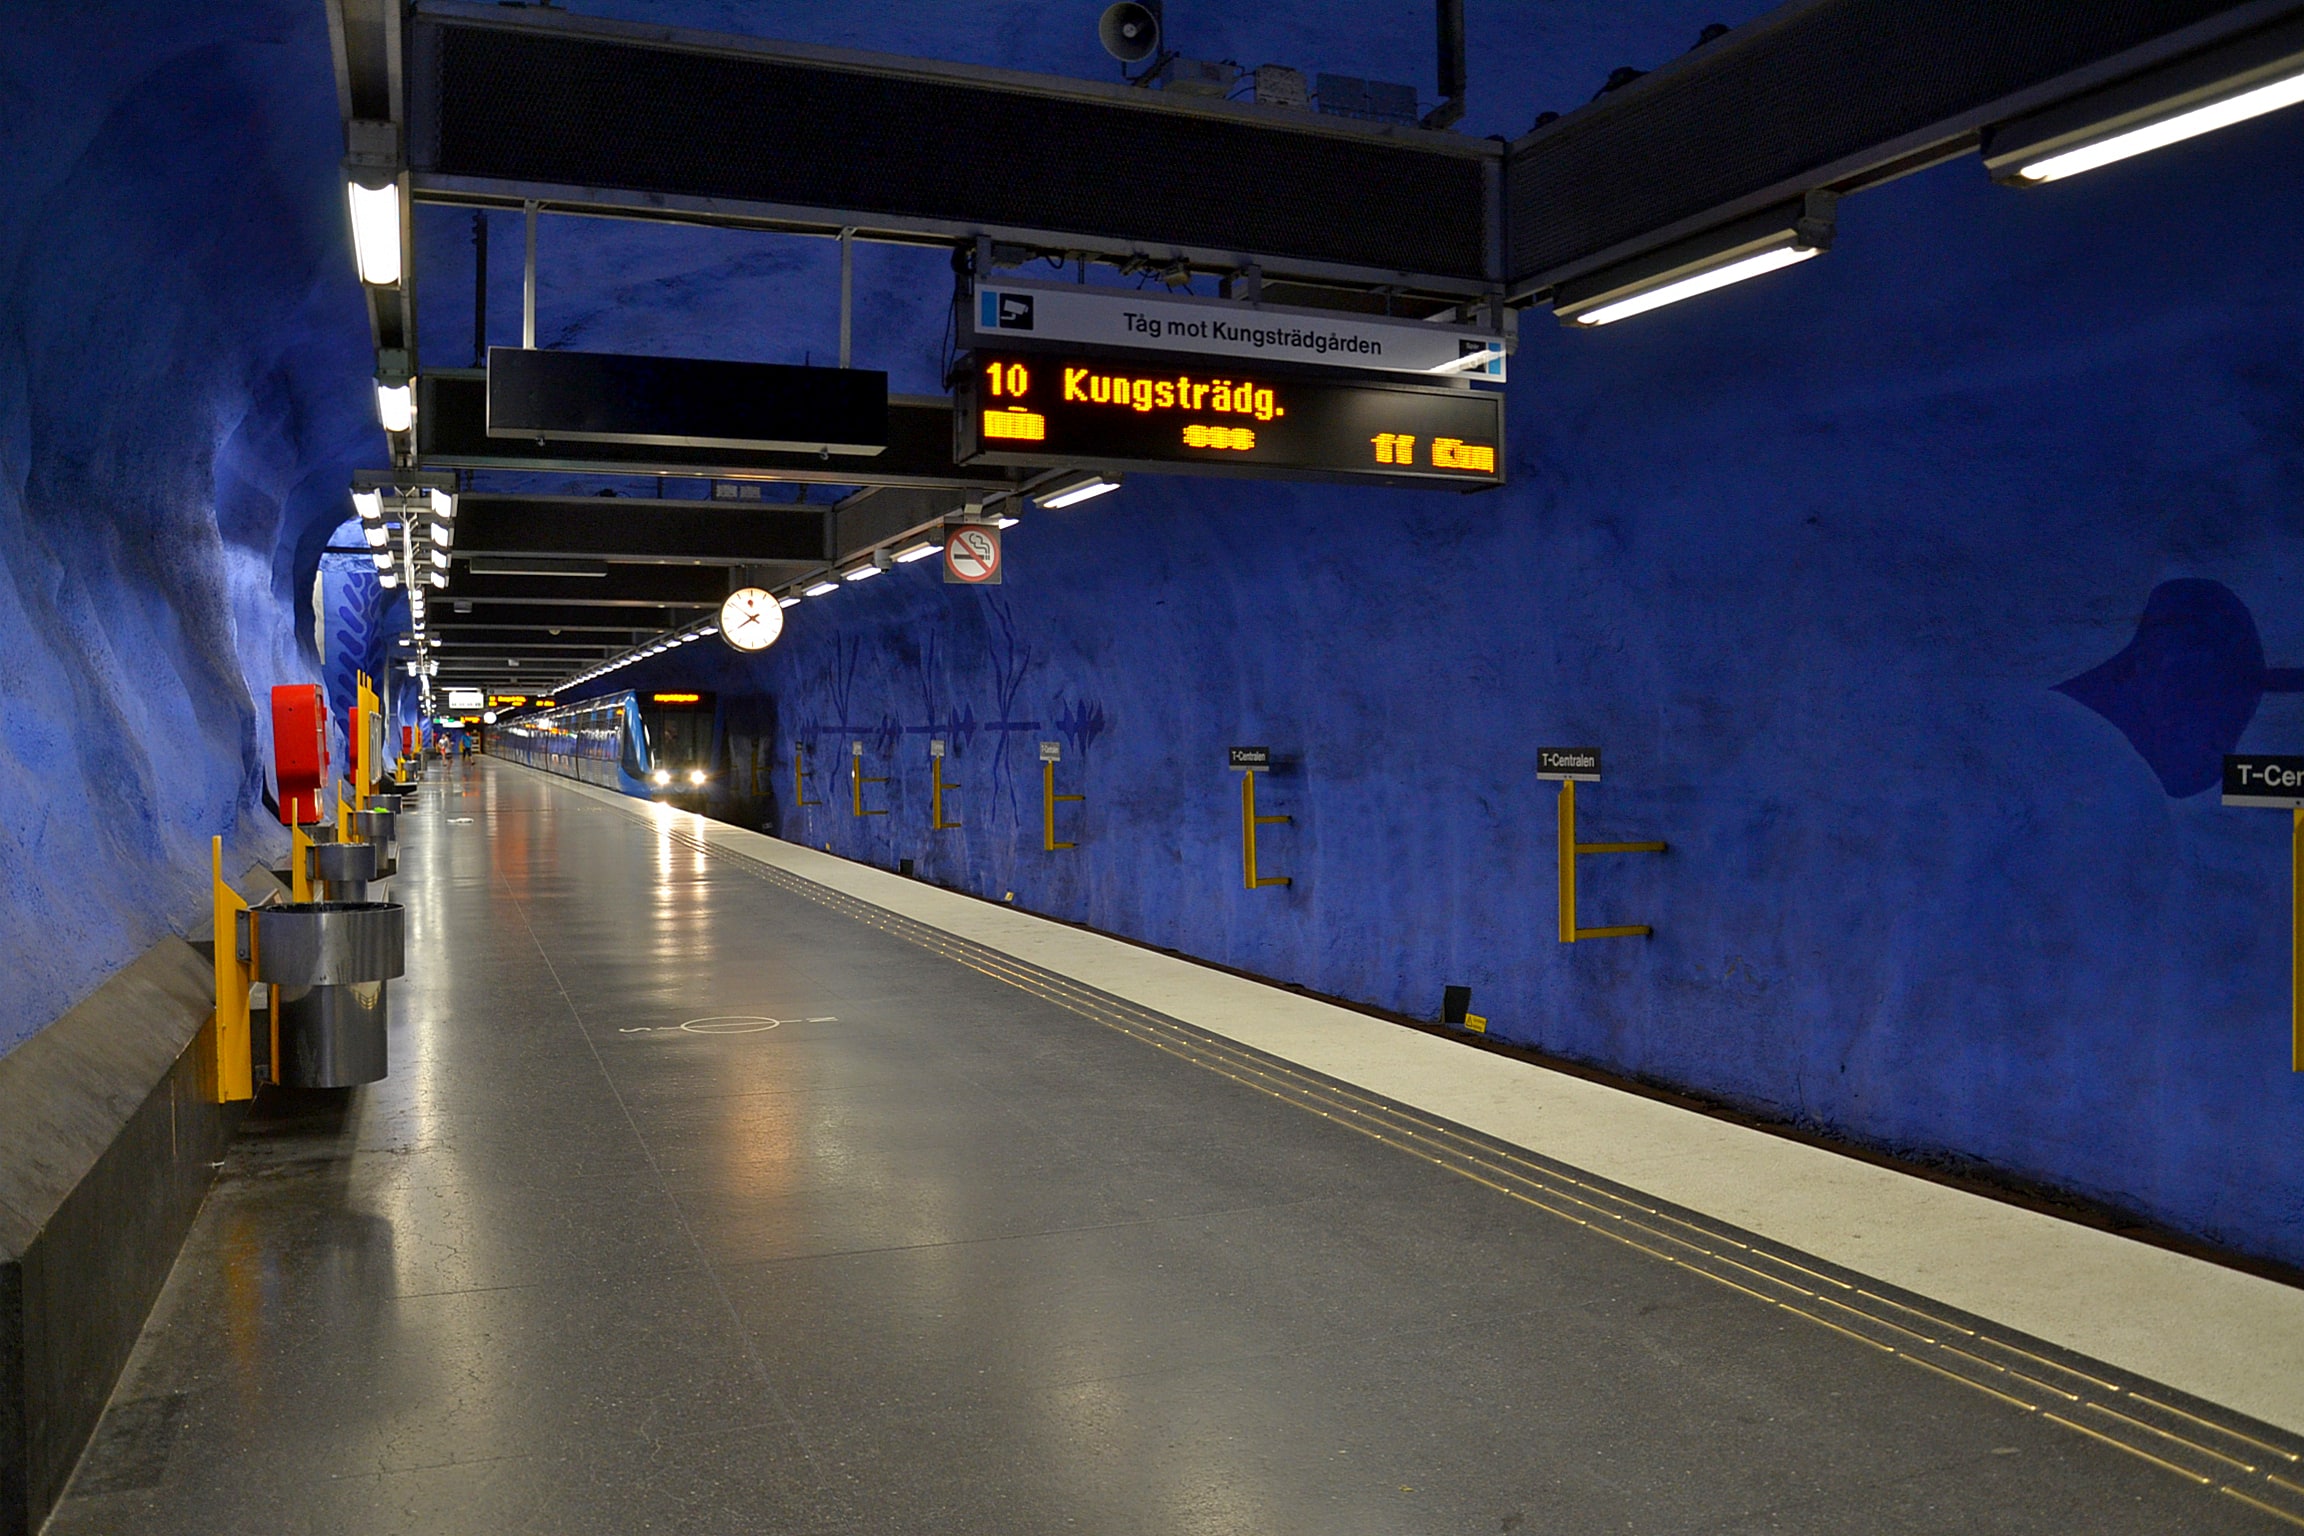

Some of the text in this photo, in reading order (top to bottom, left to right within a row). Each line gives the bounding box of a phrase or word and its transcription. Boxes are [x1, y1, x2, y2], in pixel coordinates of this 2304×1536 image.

[1124, 313, 1382, 355] Tåg mot Kungsträdgården
[986, 362, 1284, 421] 10 Kungsträdg.
[1542, 753, 1595, 768] T-Centralen
